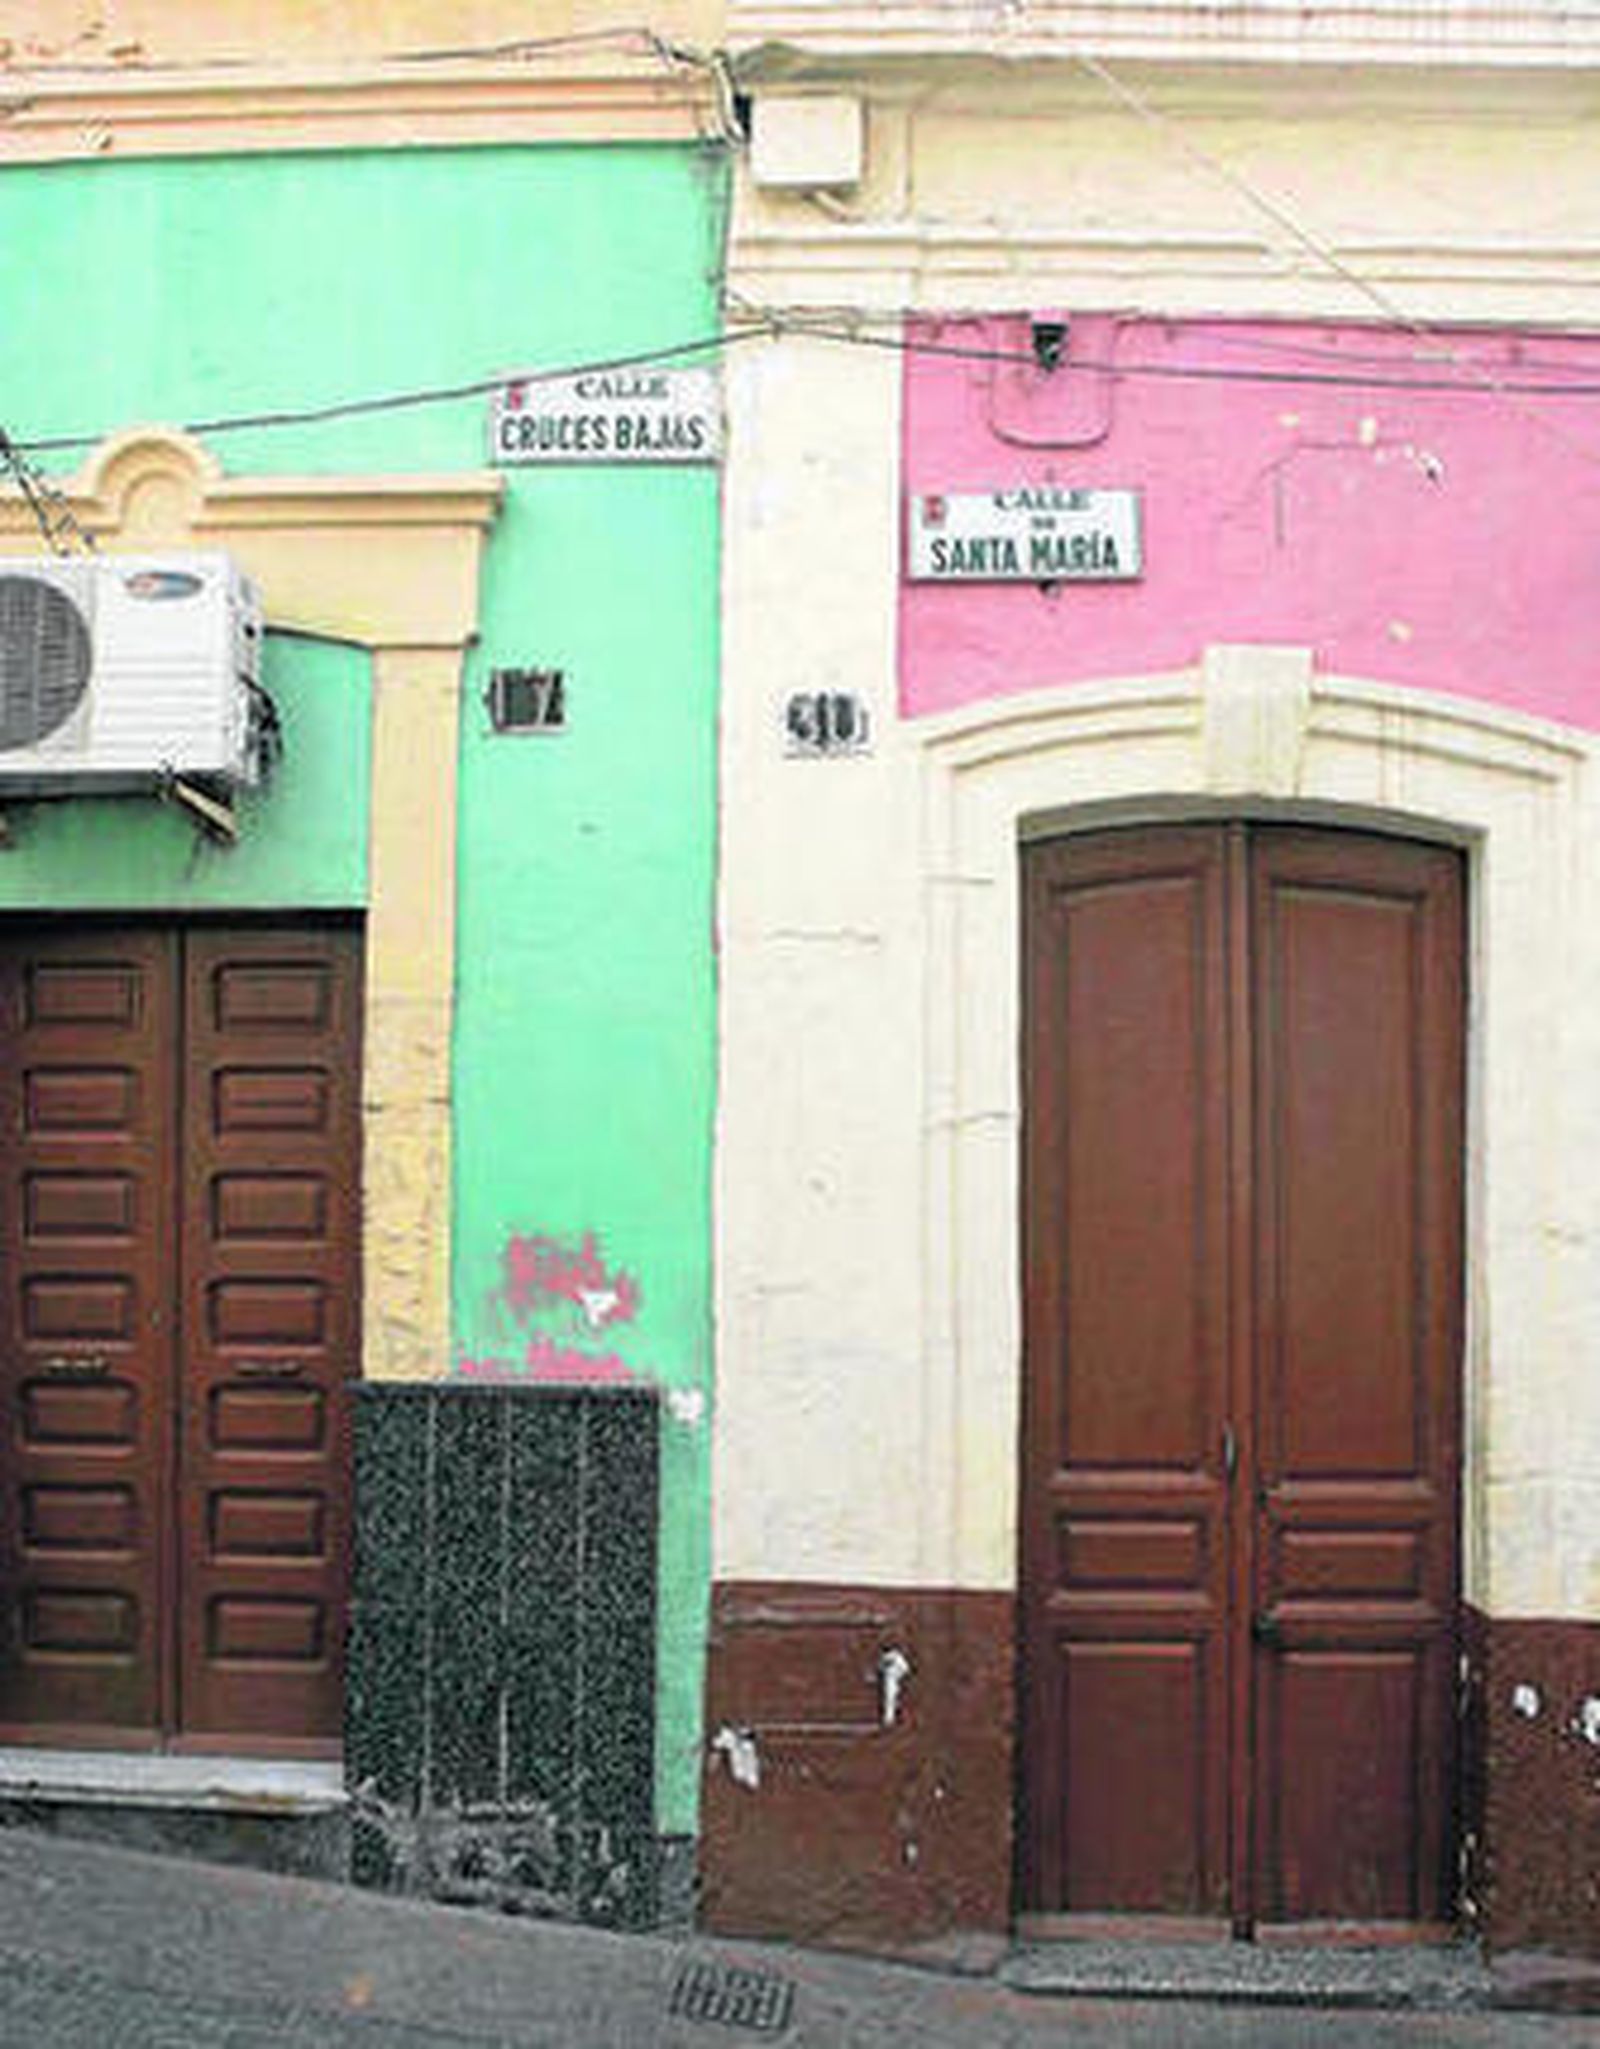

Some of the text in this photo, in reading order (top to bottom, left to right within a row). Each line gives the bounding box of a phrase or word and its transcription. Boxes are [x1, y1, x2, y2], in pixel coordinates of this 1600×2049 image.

[573, 374, 671, 398] CALLE
[501, 415, 704, 451] CRUCES BAJAS
[993, 489, 1090, 511] CALLE
[929, 529, 1120, 573] SANTA MARÍA
